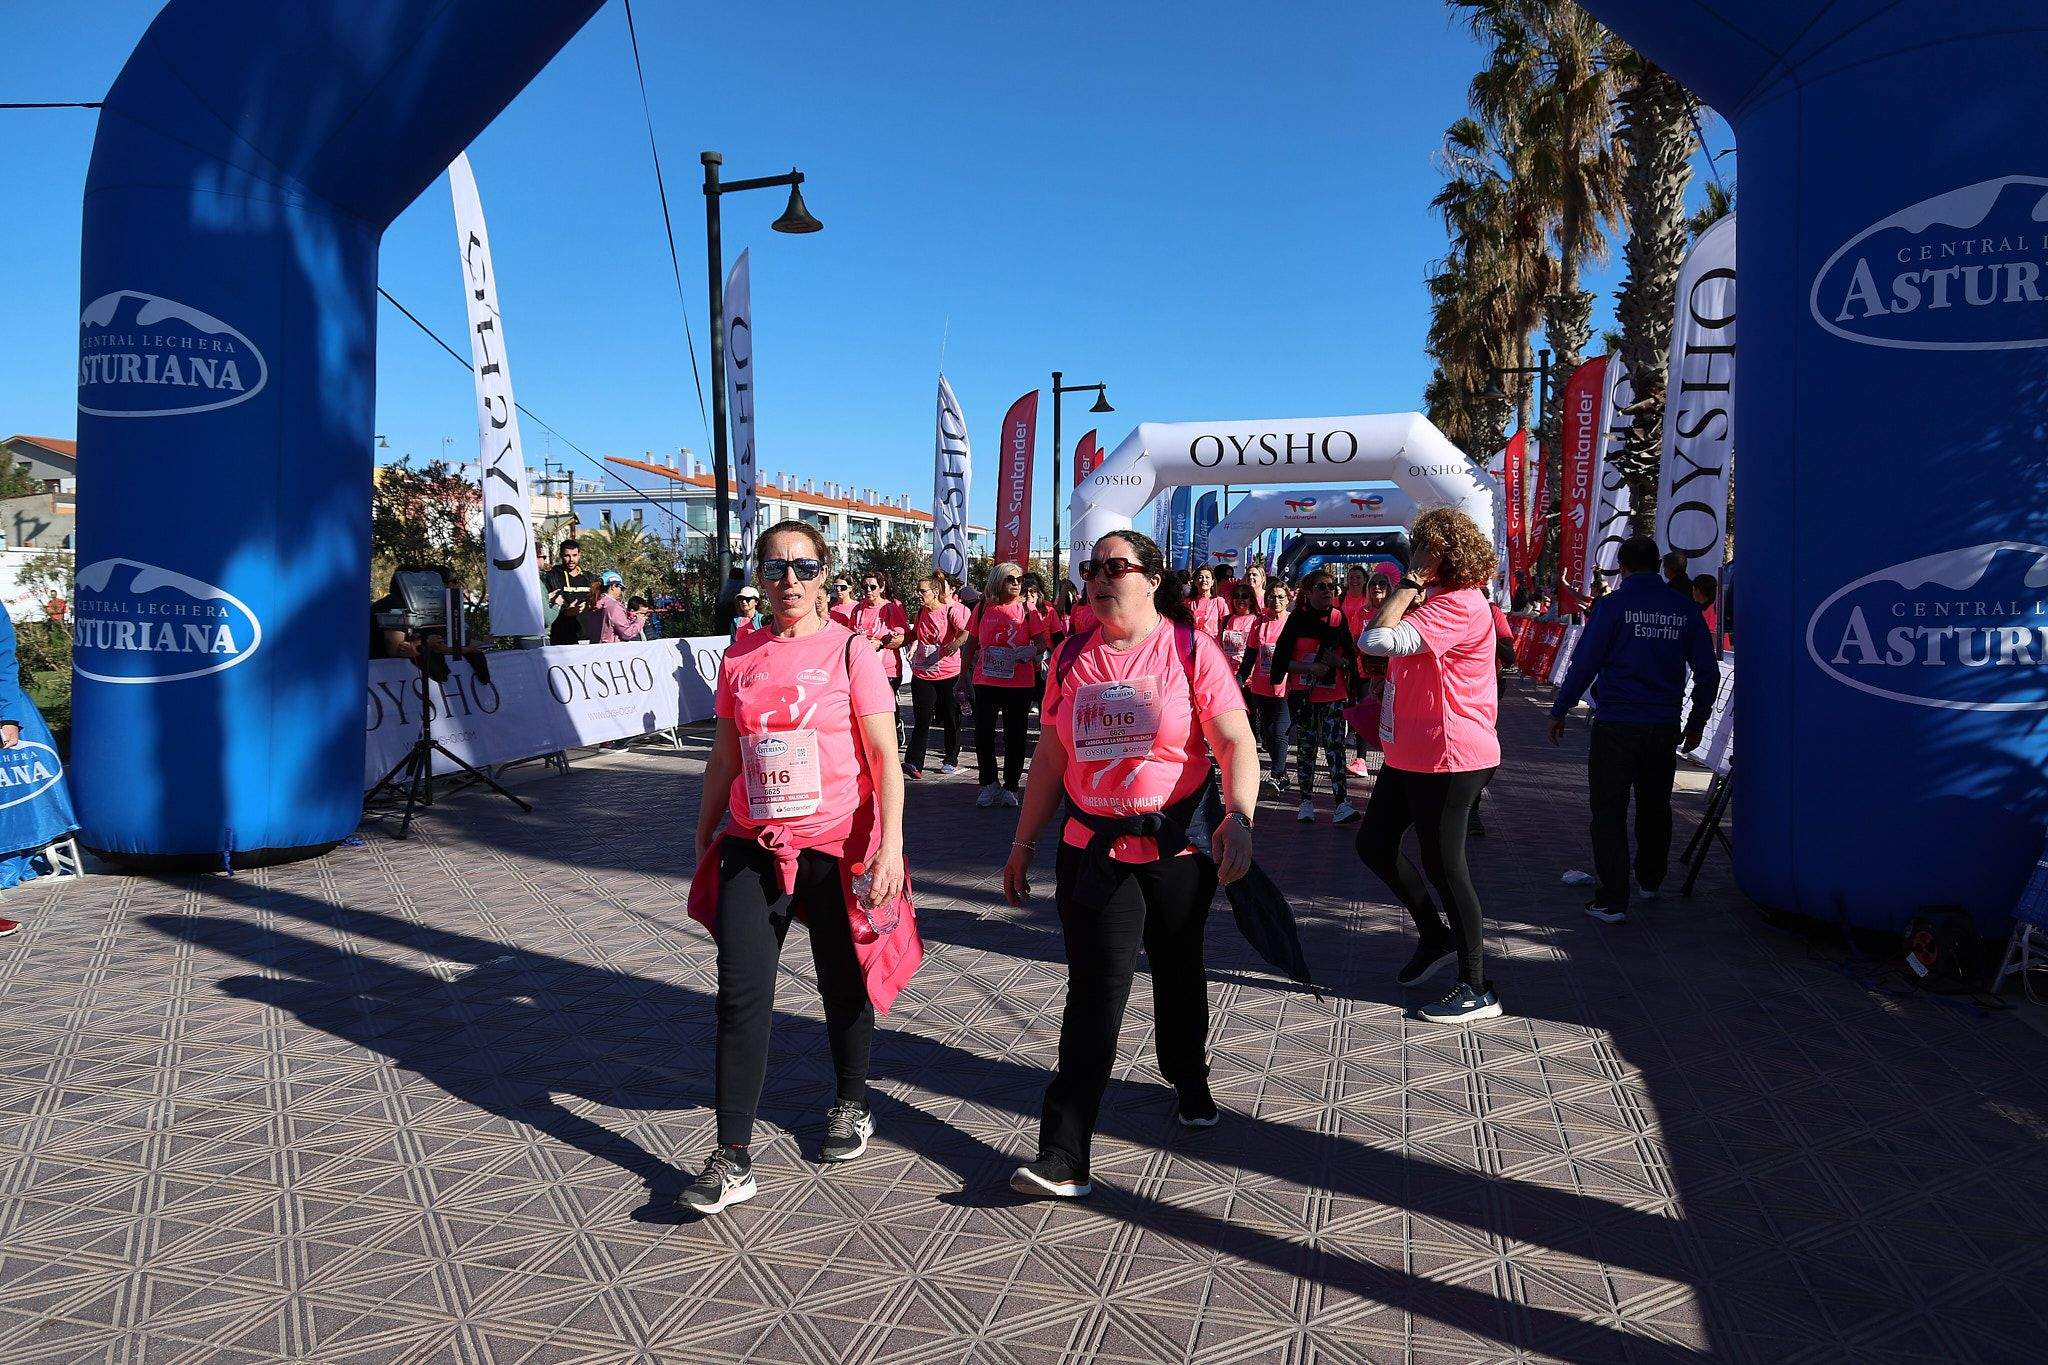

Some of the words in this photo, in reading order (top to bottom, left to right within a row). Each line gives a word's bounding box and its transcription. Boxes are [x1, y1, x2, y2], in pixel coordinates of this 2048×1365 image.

[1897, 235, 2029, 263] CENTRAL
[1835, 257, 2048, 322] ASTUR
[82, 334, 135, 350] CENTRAL
[143, 335, 236, 354] LECHERA
[78, 352, 245, 392] STURIANA
[1667, 267, 1737, 560] OYSHO
[1190, 429, 1358, 469] OYSHO
[1572, 389, 1595, 500] Santander
[1009, 420, 1028, 513] Santander
[1409, 464, 1462, 478] OYSHO
[1095, 474, 1142, 488] OYSHO
[1511, 453, 1521, 529] Santander
[939, 407, 968, 577] OYSHO
[1316, 540, 1385, 548] VOLVO
[137, 603, 229, 619] LECHERA
[1624, 609, 1688, 628] Voluntariat
[1891, 600, 2022, 618] CENTRAL
[73, 617, 240, 655] STURIANA
[1634, 624, 1680, 641] Esportiu
[547, 656, 655, 706] OYSHO
[1103, 712, 1134, 727] 016
[1085, 747, 1113, 757] OYSHO
[760, 769, 791, 786] 016
[1134, 795, 1164, 808] MUJER
